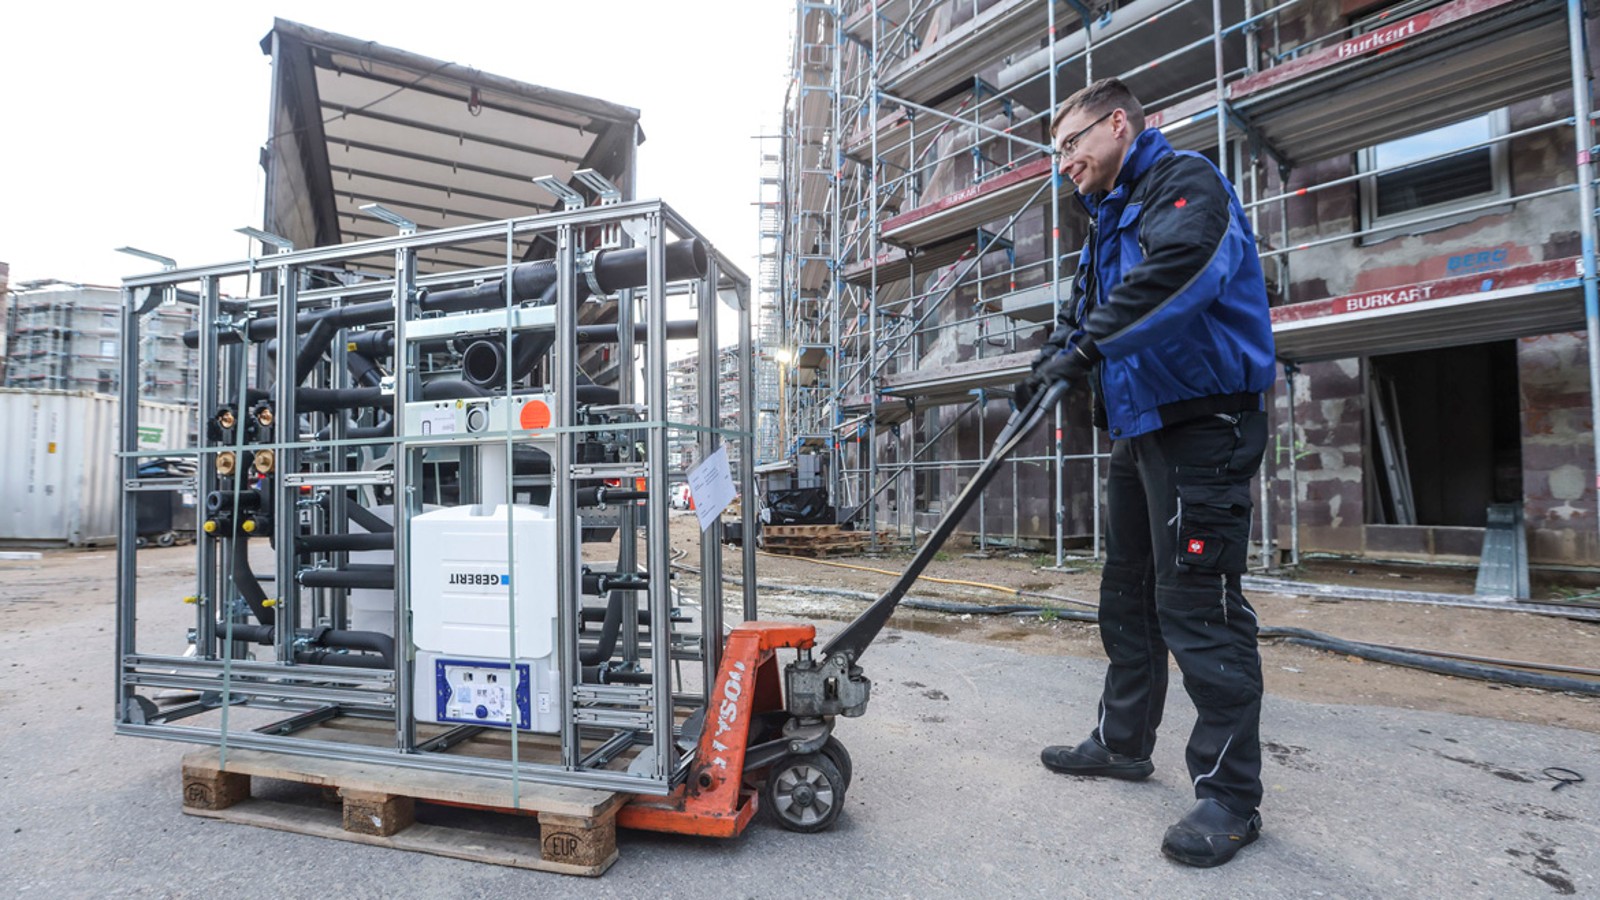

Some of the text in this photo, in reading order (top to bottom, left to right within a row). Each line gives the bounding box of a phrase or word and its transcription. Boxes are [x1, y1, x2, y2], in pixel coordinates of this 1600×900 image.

[1339, 20, 1415, 58] Burkart
[1346, 286, 1433, 311] BURKART
[448, 573, 500, 586] GEBERIT
[553, 837, 580, 858] EUR
